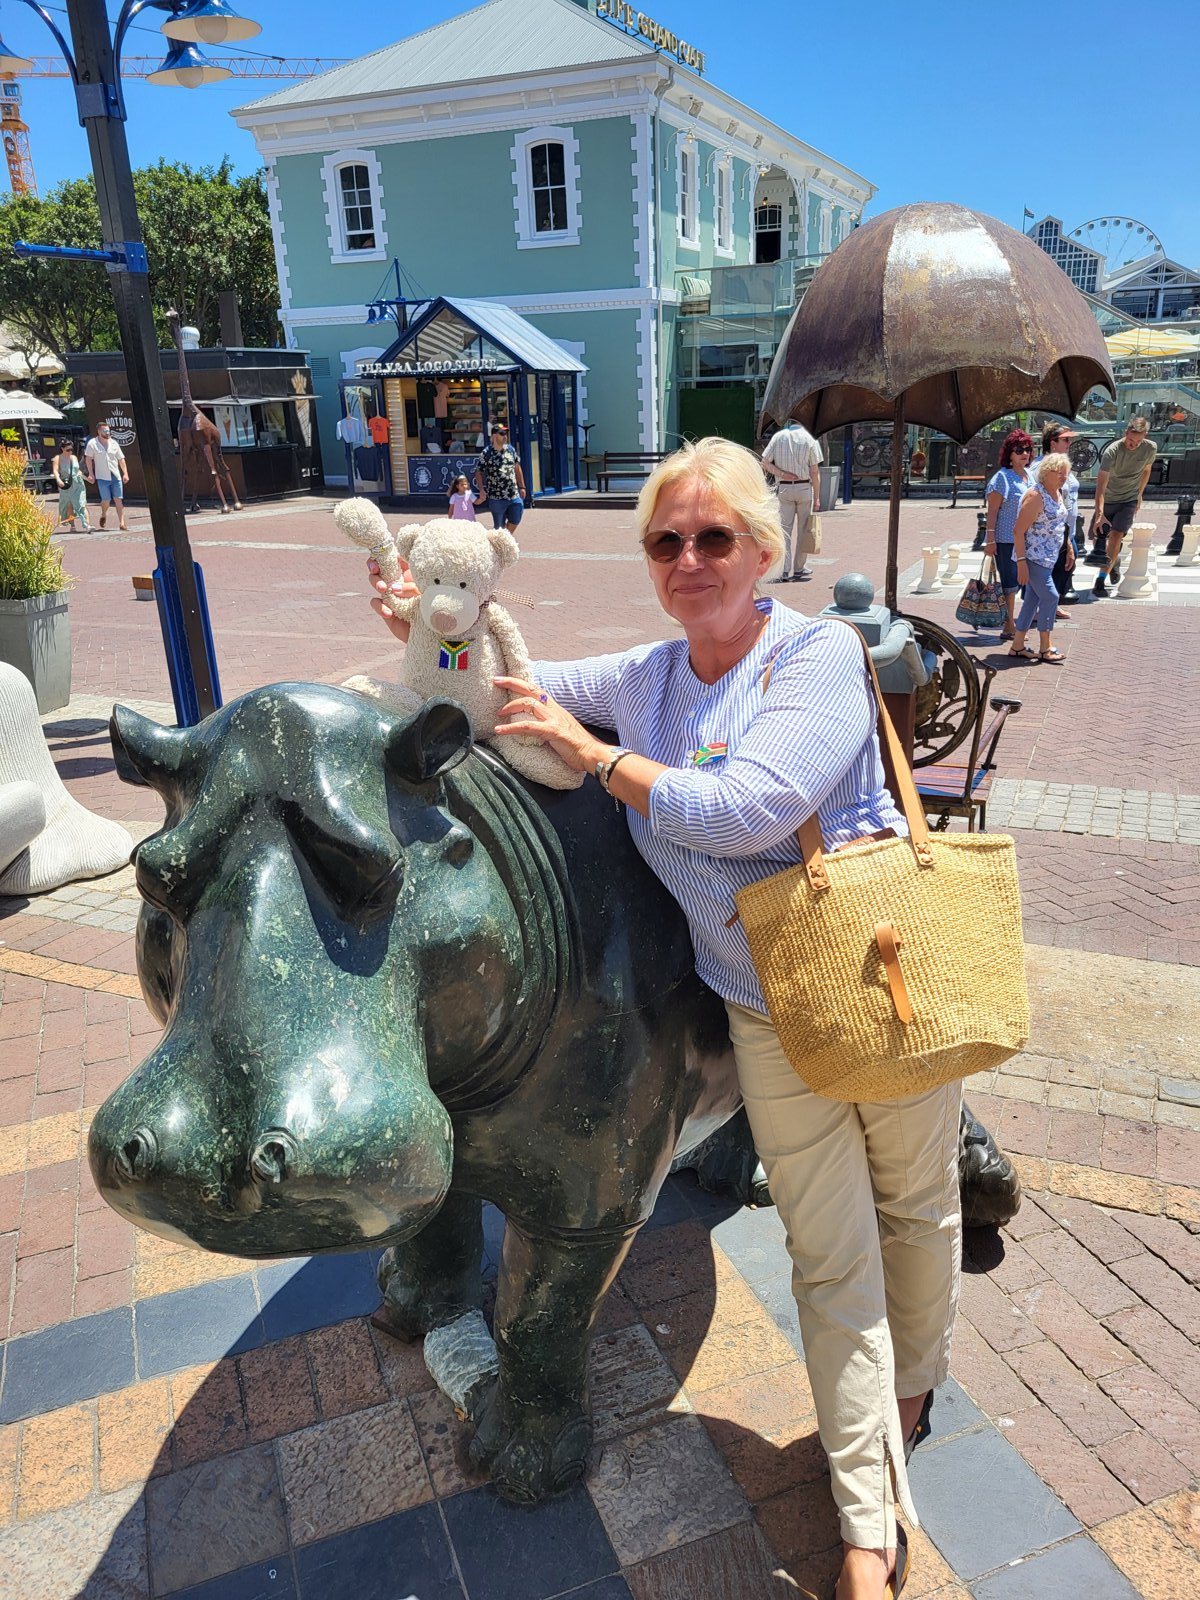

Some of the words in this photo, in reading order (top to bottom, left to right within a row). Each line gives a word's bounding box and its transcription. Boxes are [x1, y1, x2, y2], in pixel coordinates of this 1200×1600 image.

[638, 11, 678, 54] GRAND
[356, 362, 381, 374] THE
[385, 361, 412, 373] V&A
[416, 360, 452, 372] LOGO
[455, 358, 497, 370] STORE
[105, 417, 119, 427] HOT
[119, 417, 133, 428] DOG
